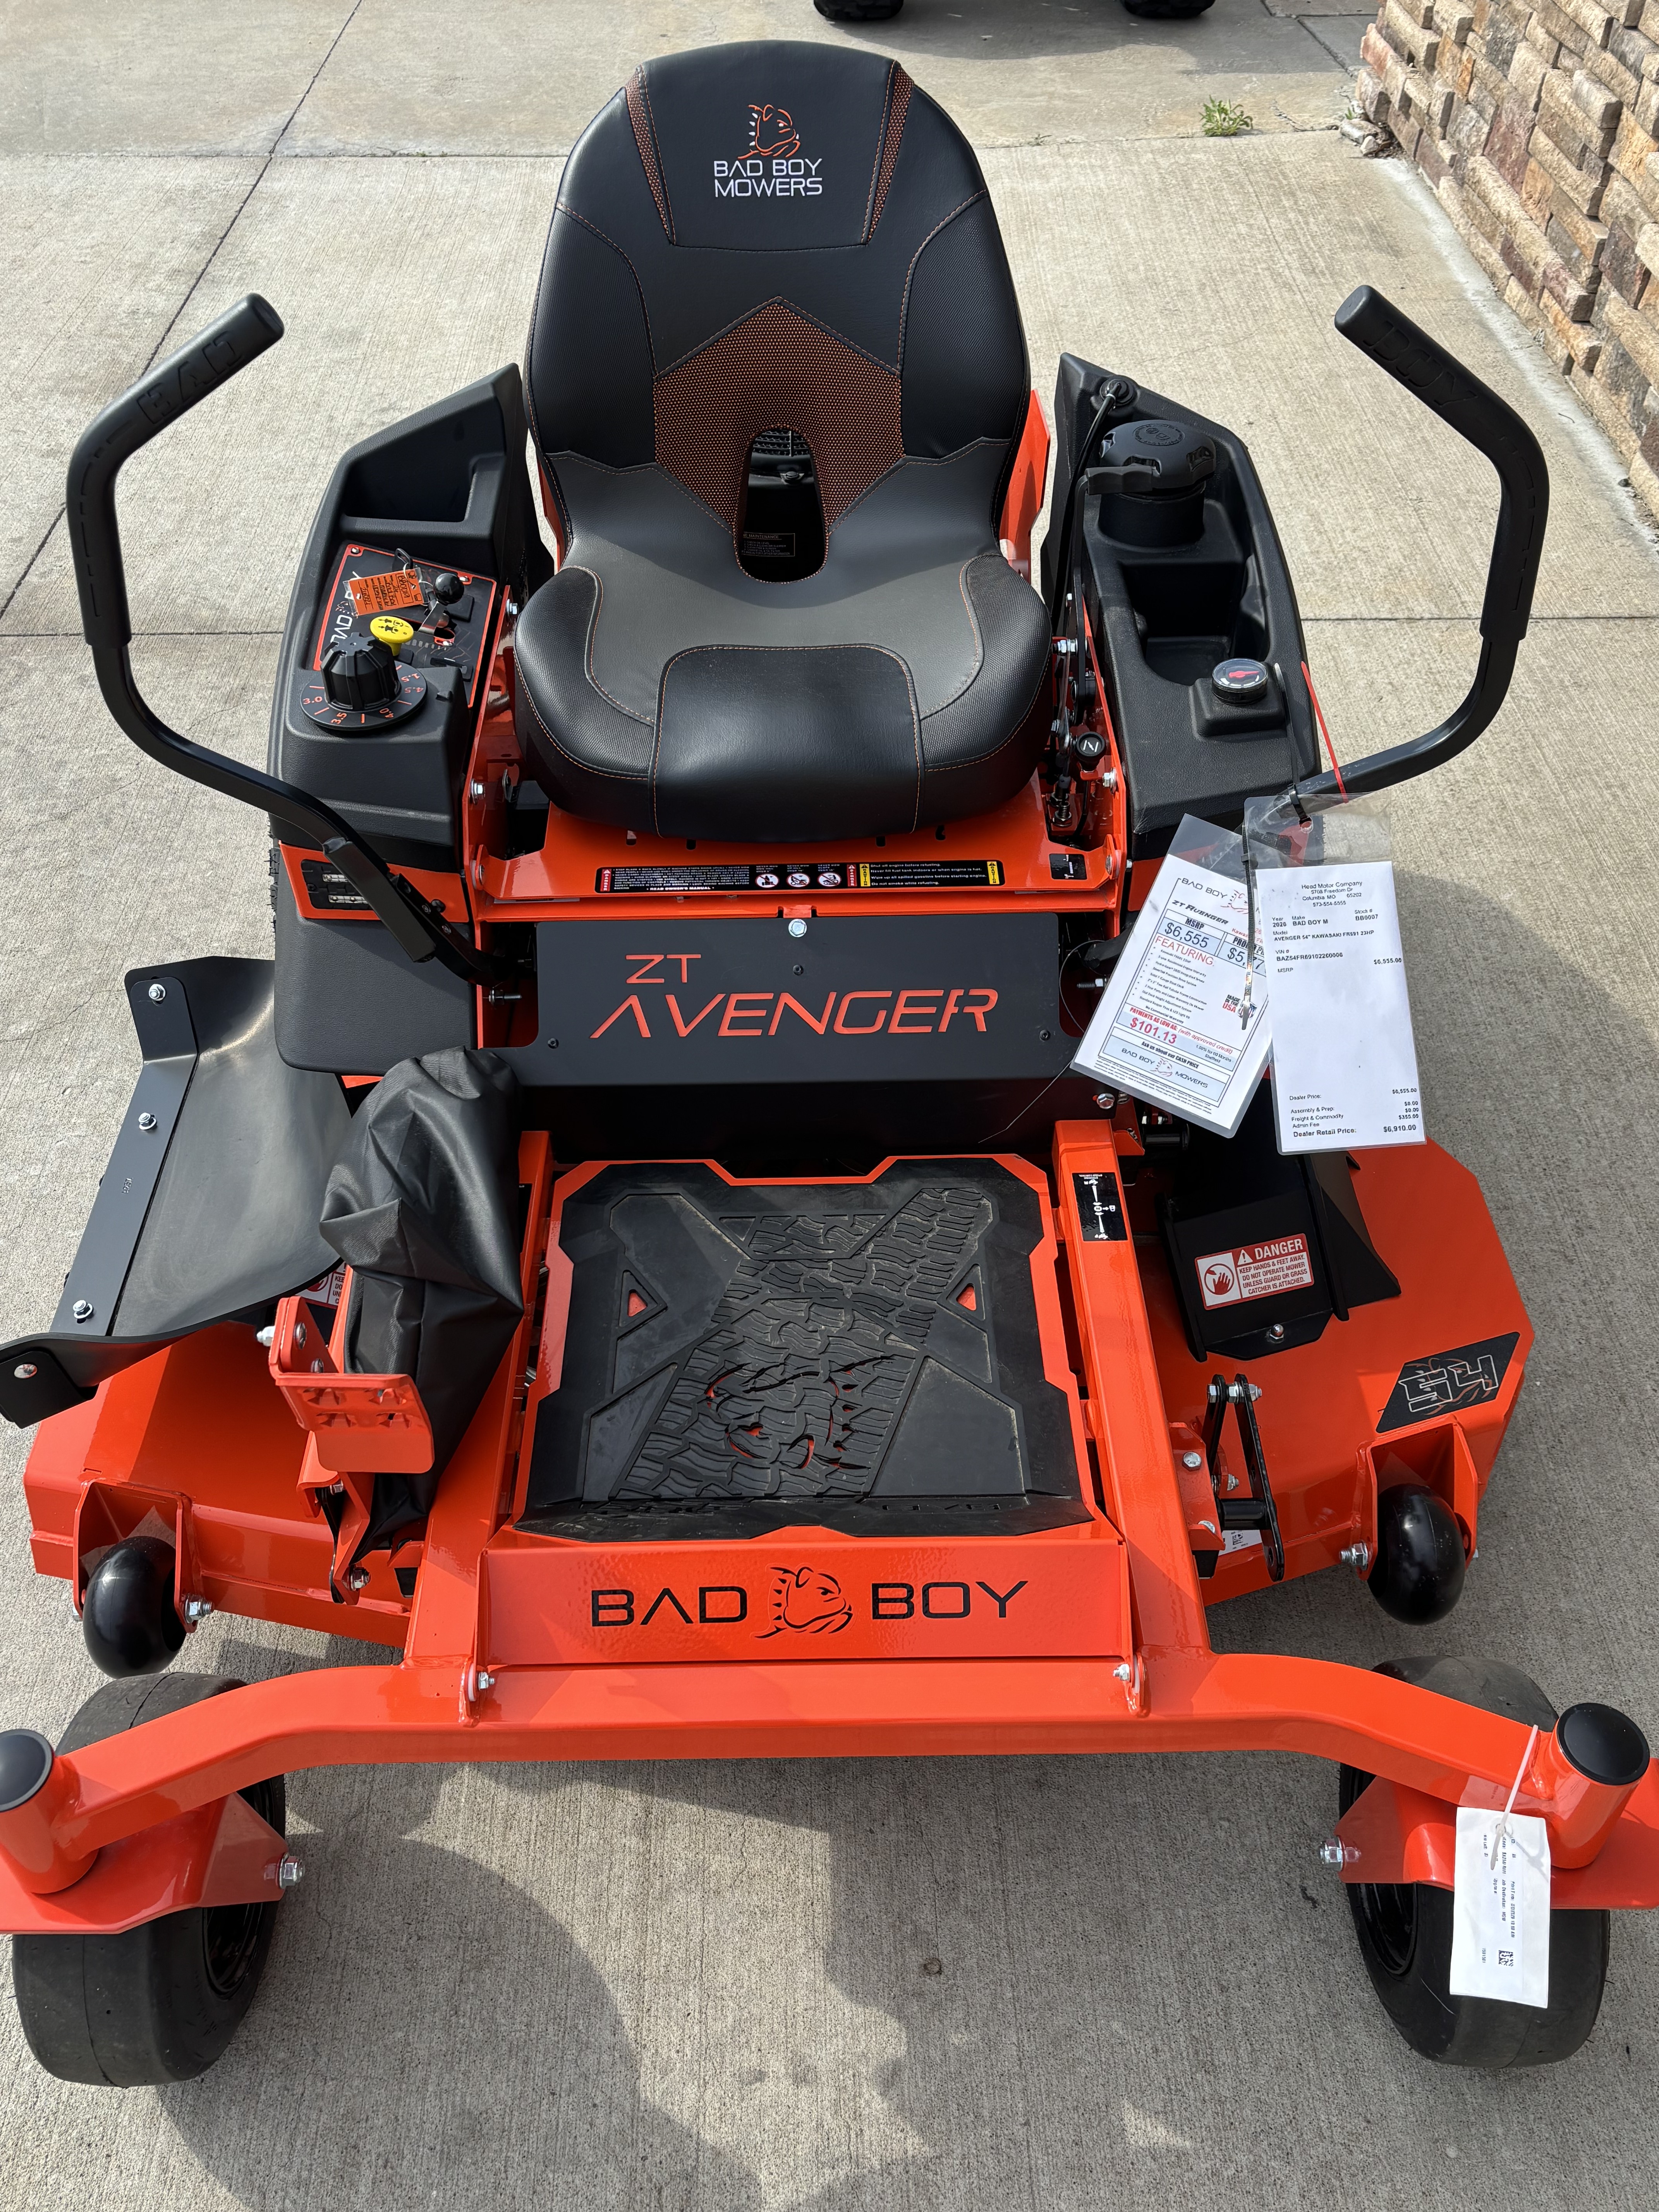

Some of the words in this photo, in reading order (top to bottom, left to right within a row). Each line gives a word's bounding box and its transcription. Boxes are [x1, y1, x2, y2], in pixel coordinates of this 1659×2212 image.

[714, 160, 763, 177] BAD
[772, 158, 823, 176] BOY
[714, 177, 823, 198] MOWERS
[401, 672, 421, 683] 1.5
[303, 696, 323, 705] 3.0
[330, 712, 347, 725] 3.5
[379, 708, 395, 719] 4.0
[1182, 878, 1203, 890] BAD
[1205, 887, 1228, 898] BOY
[1185, 918, 1204, 930] MSRP
[1164, 922, 1209, 948] $6,555
[625, 953, 702, 984] ZT
[589, 988, 999, 1039] AVENGER
[1222, 1001, 1236, 1013] USA
[1130, 1007, 1154, 1020] PAYMENTS
[1159, 1019, 1171, 1028] LOW
[1128, 1017, 1177, 1044] $101.13
[1121, 1048, 1137, 1058] BAD
[1139, 1055, 1155, 1065] BOY
[1175, 1071, 1208, 1088] MOWERS
[1383, 1124, 1416, 1133] $6,910.00
[1254, 1238, 1304, 1260] DANGER
[1239, 1266, 1252, 1274] KEEP
[1253, 1262, 1271, 1271] HANDS
[1277, 1257, 1289, 1266] FEET
[1290, 1254, 1305, 1262] AWAY.
[1262, 1267, 1285, 1277] OPERATE
[1286, 1261, 1305, 1272] MOWER
[1243, 1279, 1263, 1288] UNLESS
[1264, 1275, 1281, 1284] GUARD
[1291, 1269, 1308, 1278] GRASS
[1248, 1285, 1271, 1295] CATCHER
[1278, 1276, 1305, 1288] ATTACHED.
[1398, 1354, 1499, 1413] 54
[591, 1585, 747, 1627] BAD
[871, 1580, 1029, 1620] BOY
